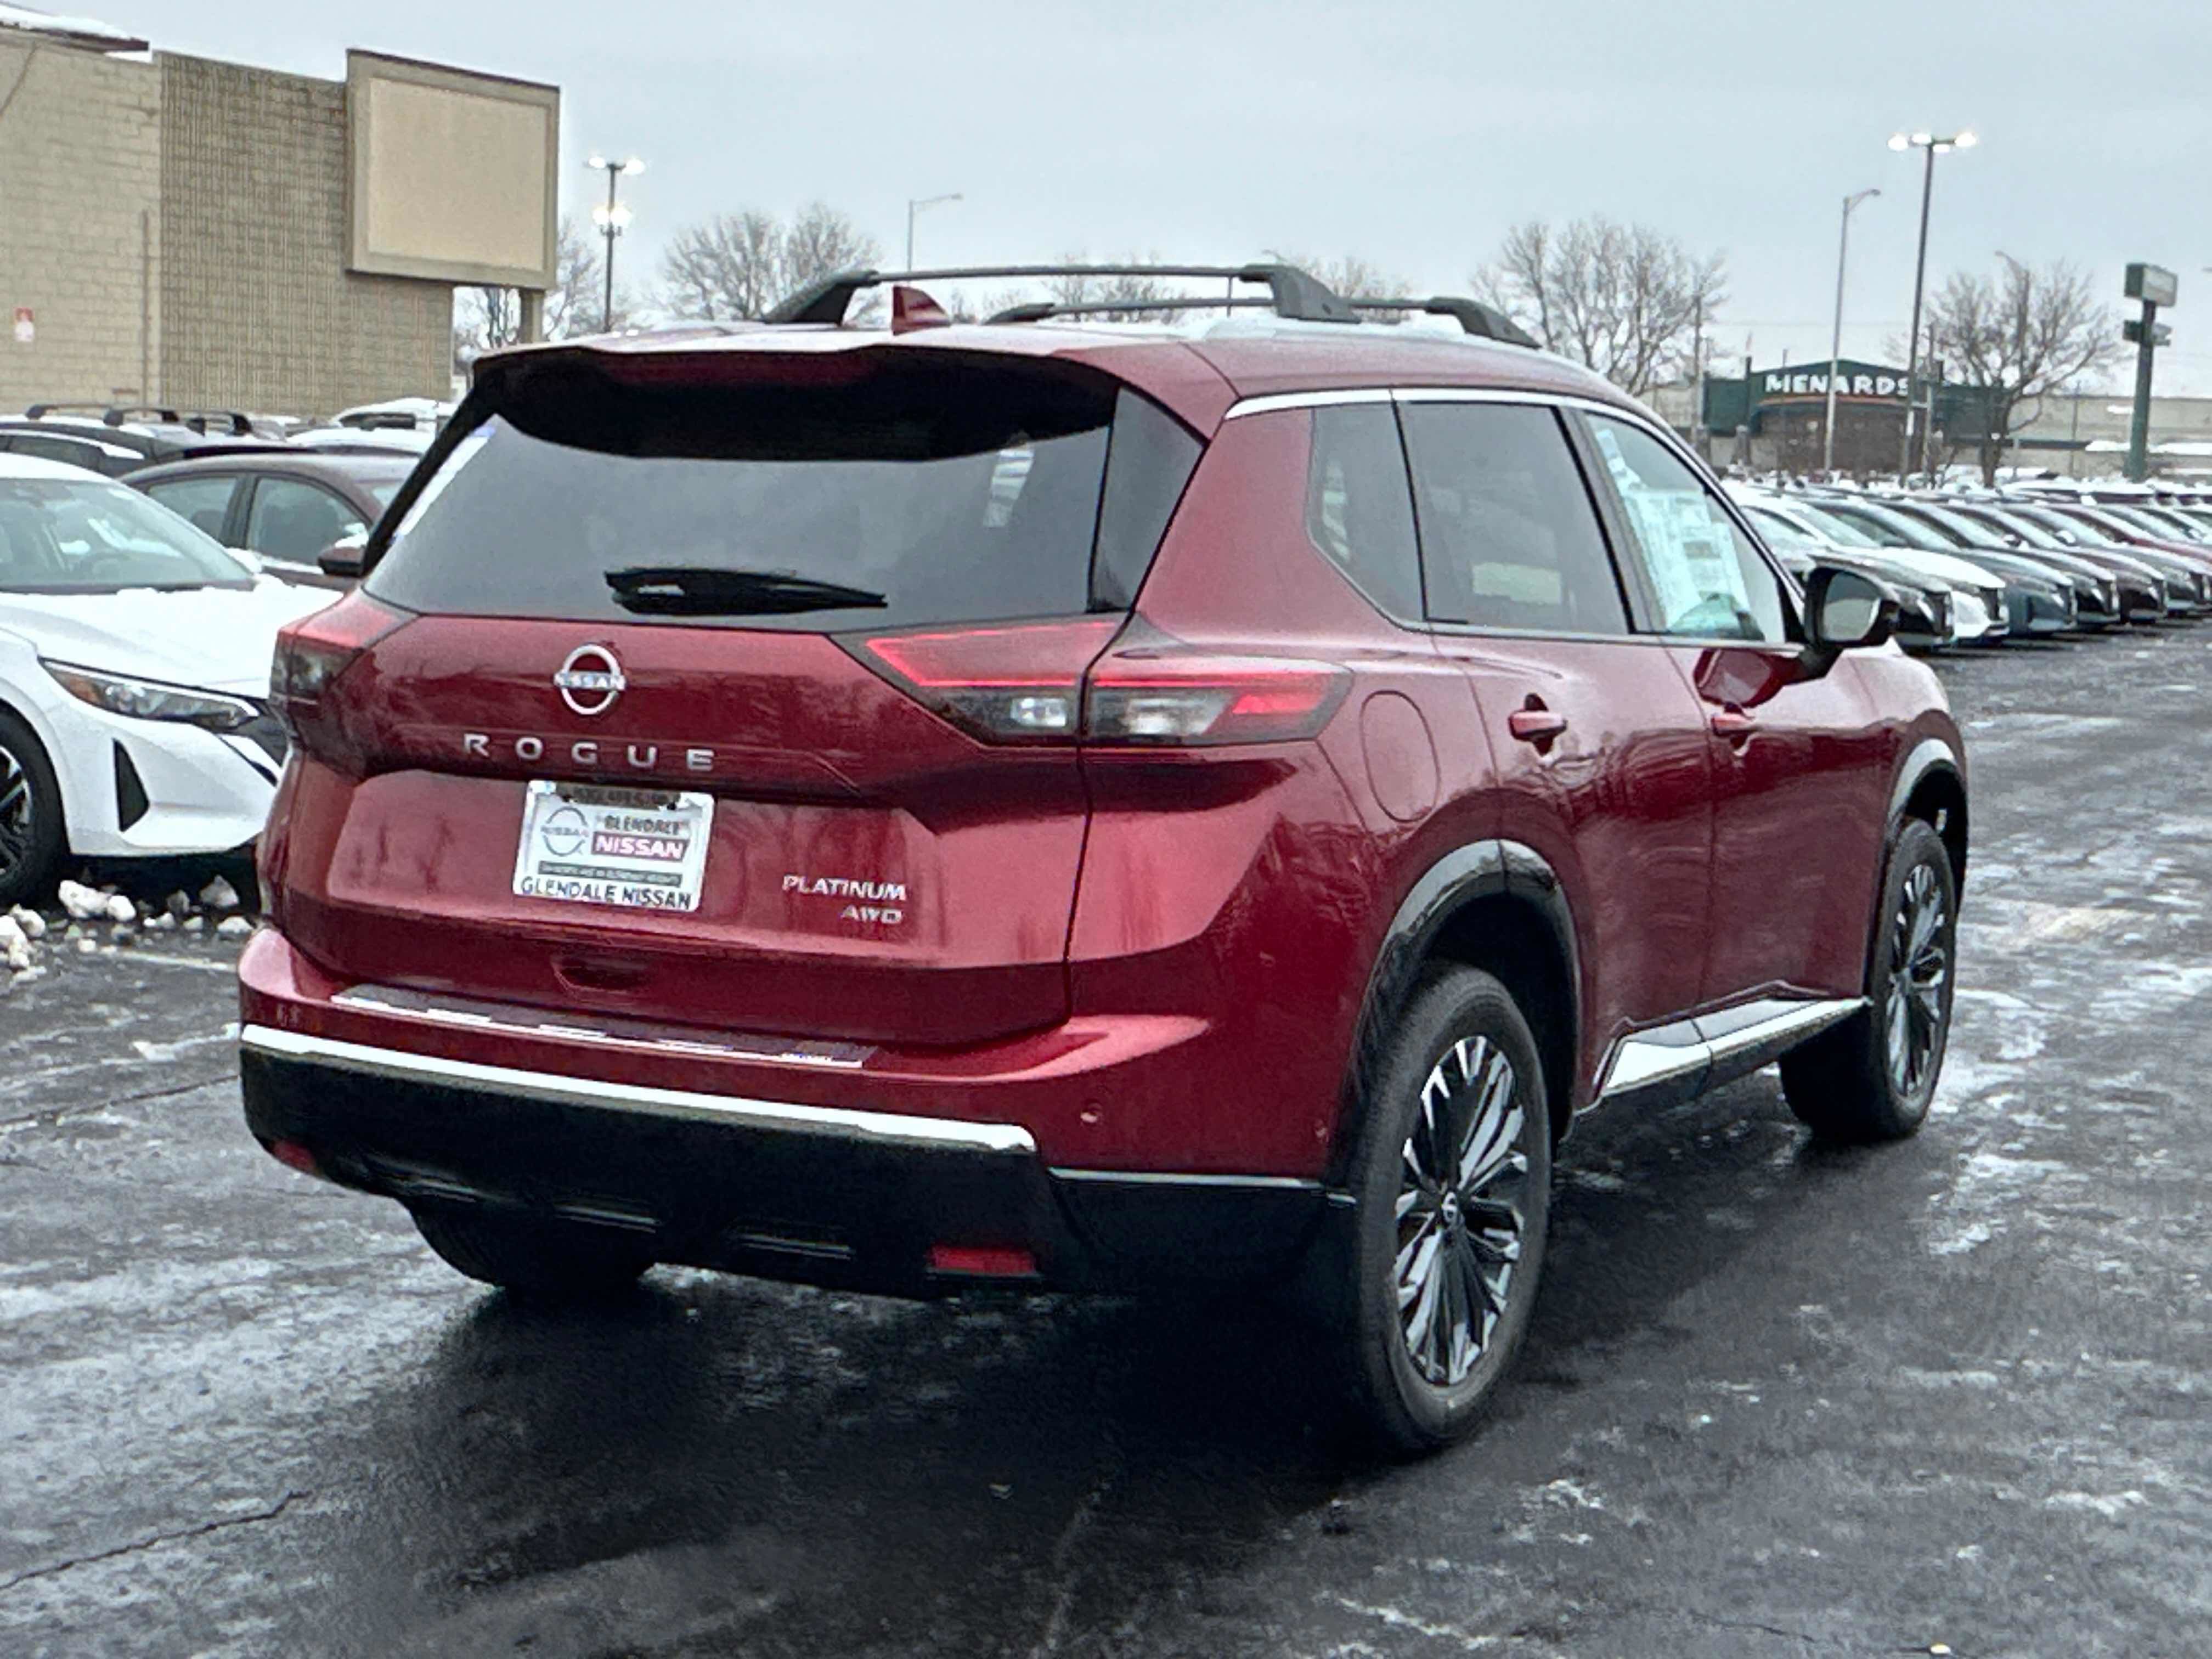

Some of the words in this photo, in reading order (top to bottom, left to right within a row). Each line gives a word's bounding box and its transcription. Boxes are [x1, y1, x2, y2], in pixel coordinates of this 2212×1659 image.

[1765, 374, 1908, 396] MENARDS
[463, 733, 714, 770] ROGUE
[595, 836, 684, 856] NISSAN
[521, 876, 617, 902] GLENDALE
[622, 886, 691, 909] NISSAN
[782, 875, 906, 900] PLATINUM
[840, 905, 902, 924] AWD
